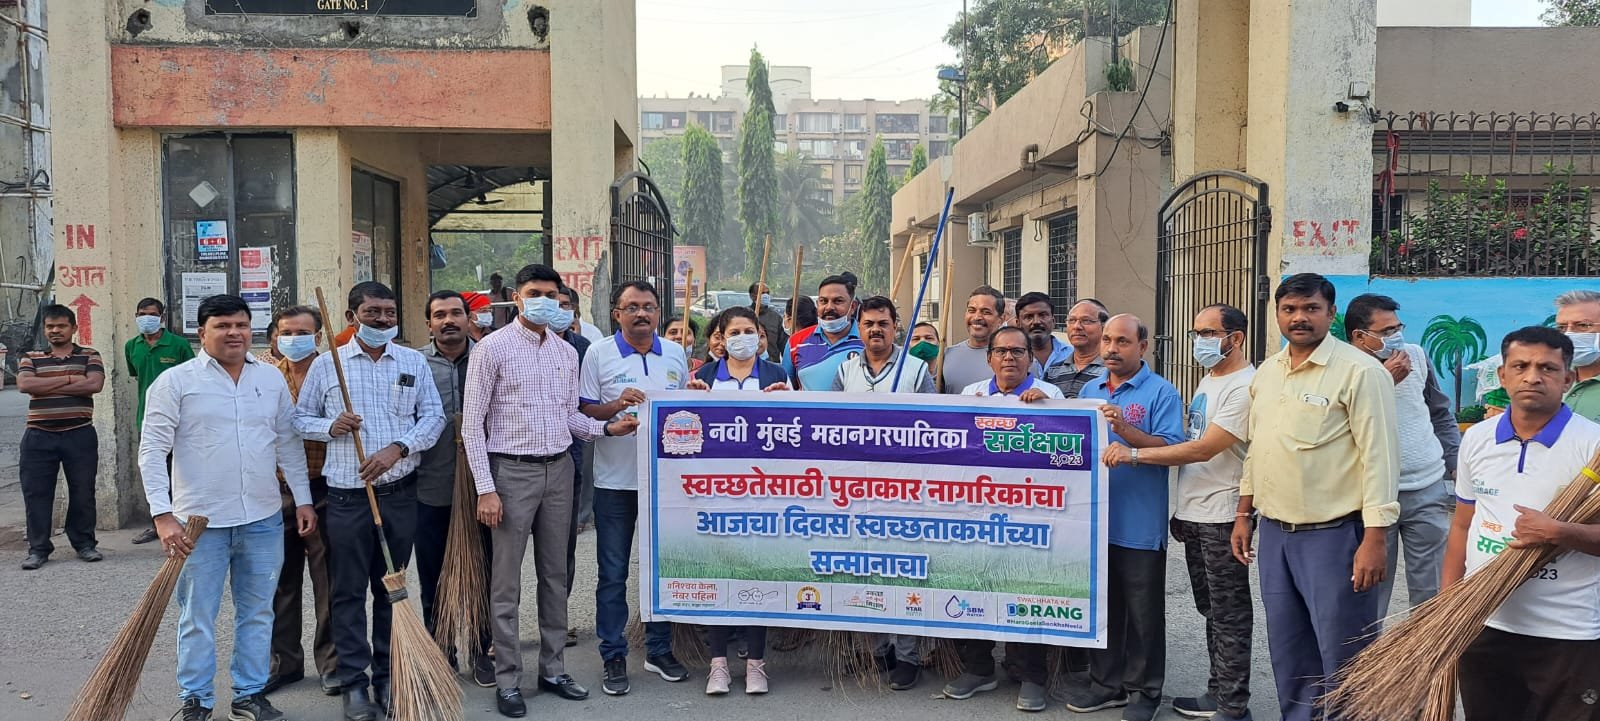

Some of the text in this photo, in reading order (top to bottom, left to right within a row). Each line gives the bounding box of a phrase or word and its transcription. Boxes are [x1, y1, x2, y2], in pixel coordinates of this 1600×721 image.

[317, 0, 341, 10] GATE
[66, 224, 95, 249] IN
[1293, 219, 1360, 247] EXIT
[555, 236, 603, 260] EXIT
[59, 266, 106, 288] आत
[708, 415, 968, 451] नवी मुंबई महानगरपालिका
[974, 416, 1017, 430] स्वच्छ
[983, 423, 1084, 456] सर्वेक्षण
[681, 466, 1065, 508] स्वच्छतेसाठी पुढाकार नागरिकांचा
[697, 505, 1050, 547] आजचा दिवस स्वच्छताकर्मींच्या
[811, 551, 928, 577] सन्मानाचा
[1031, 604, 1083, 620] RANG
